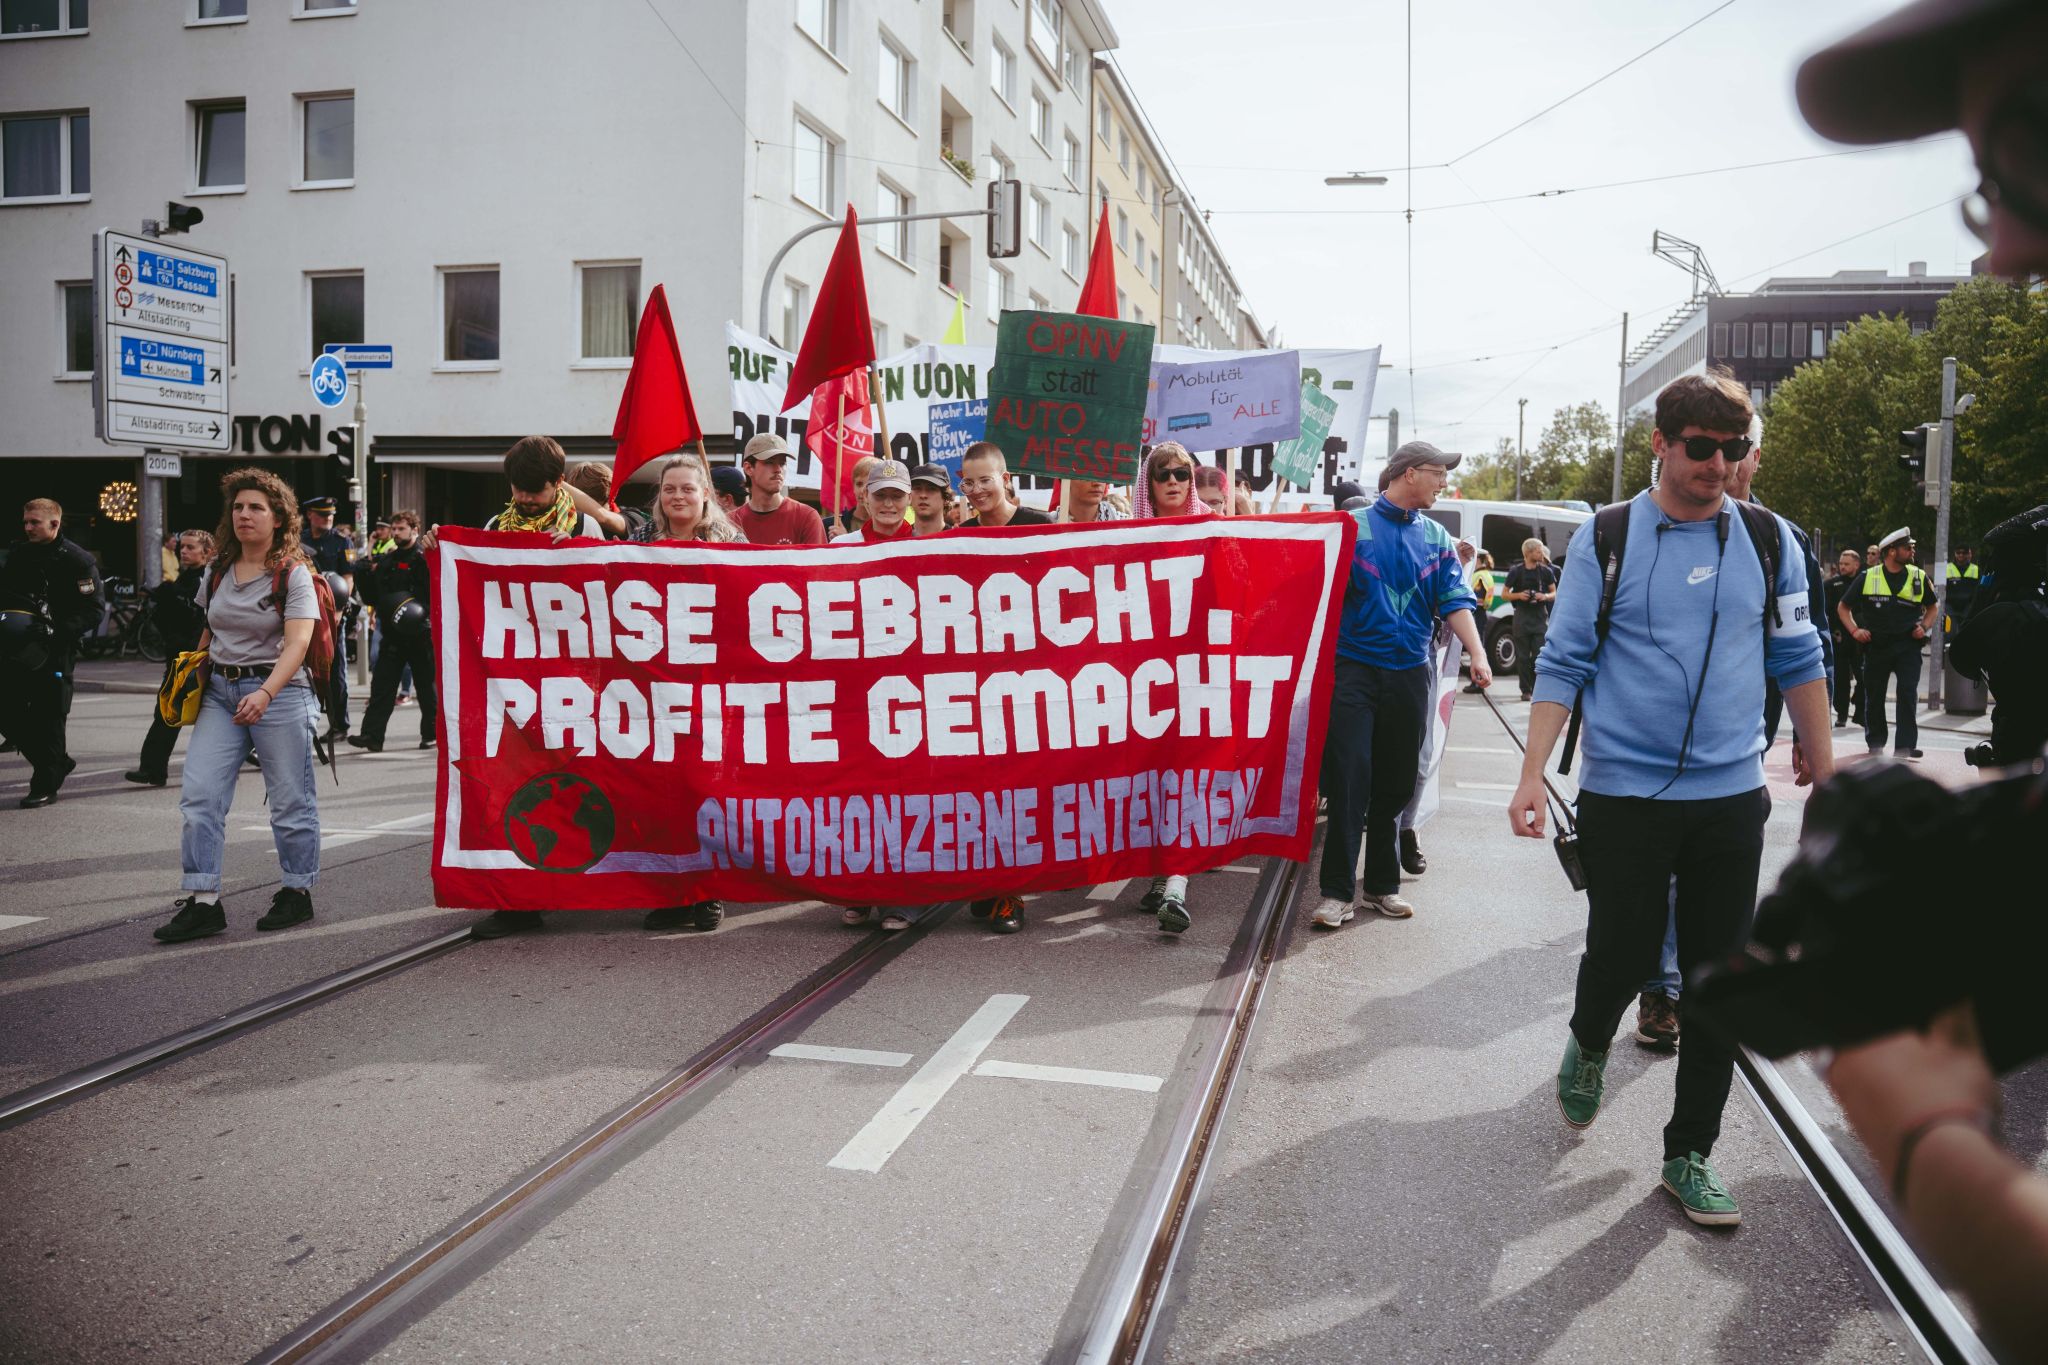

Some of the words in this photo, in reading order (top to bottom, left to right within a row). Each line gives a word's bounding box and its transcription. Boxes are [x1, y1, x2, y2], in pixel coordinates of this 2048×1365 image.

[161, 274, 170, 285] 94
[177, 276, 209, 294] Passau
[177, 262, 215, 284] Salzburg
[138, 310, 191, 332] Altstadtring
[1025, 314, 1128, 364] ÖPNV
[160, 345, 203, 366] Nürnberg
[728, 345, 778, 385] AUF
[156, 365, 189, 379] München
[1041, 368, 1100, 396] statt
[1168, 368, 1244, 390] Mobilität
[159, 386, 206, 405] Schwabing
[1211, 388, 1240, 406] für
[931, 404, 963, 420] Mehr
[965, 400, 988, 417] Loh
[993, 396, 1087, 435] AUTO
[1233, 400, 1281, 421] ALLE
[131, 415, 184, 435] Altstadtring
[187, 422, 204, 434] Süd
[232, 414, 321, 454] TON
[1019, 434, 1138, 481] MESSE
[1692, 566, 1713, 577] NIKE
[482, 580, 717, 664] KRISE
[748, 555, 1232, 663] GEBRACHT.
[486, 676, 839, 764] PROFITE
[867, 654, 1293, 758] GEMACHT
[697, 787, 1043, 877] AUTOKONZERNE
